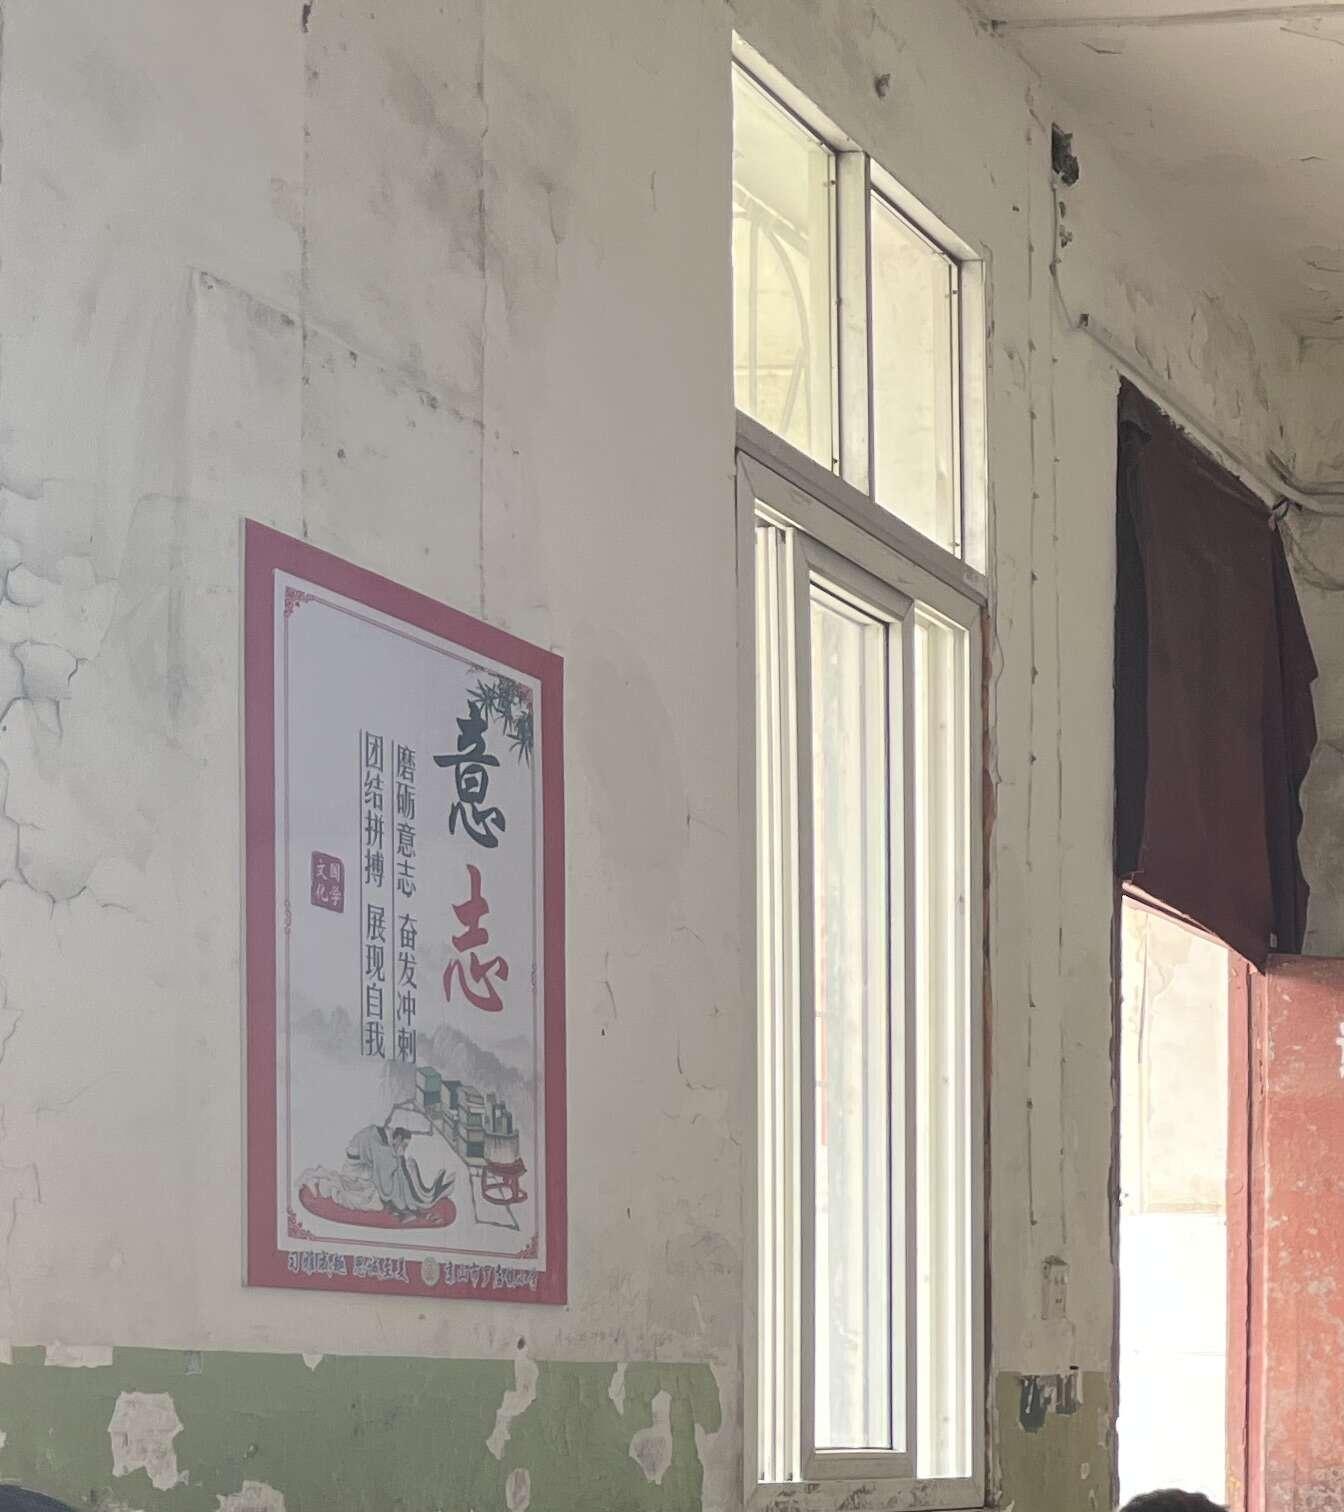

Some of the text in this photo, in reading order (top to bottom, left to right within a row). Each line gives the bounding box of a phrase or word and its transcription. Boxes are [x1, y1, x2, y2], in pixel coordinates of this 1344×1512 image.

[363, 730, 386, 1059] 团结拼搏 展现自我
[396, 744, 418, 1065] 磨砺意志 奋发冲刺
[433, 698, 511, 1013] 意志
